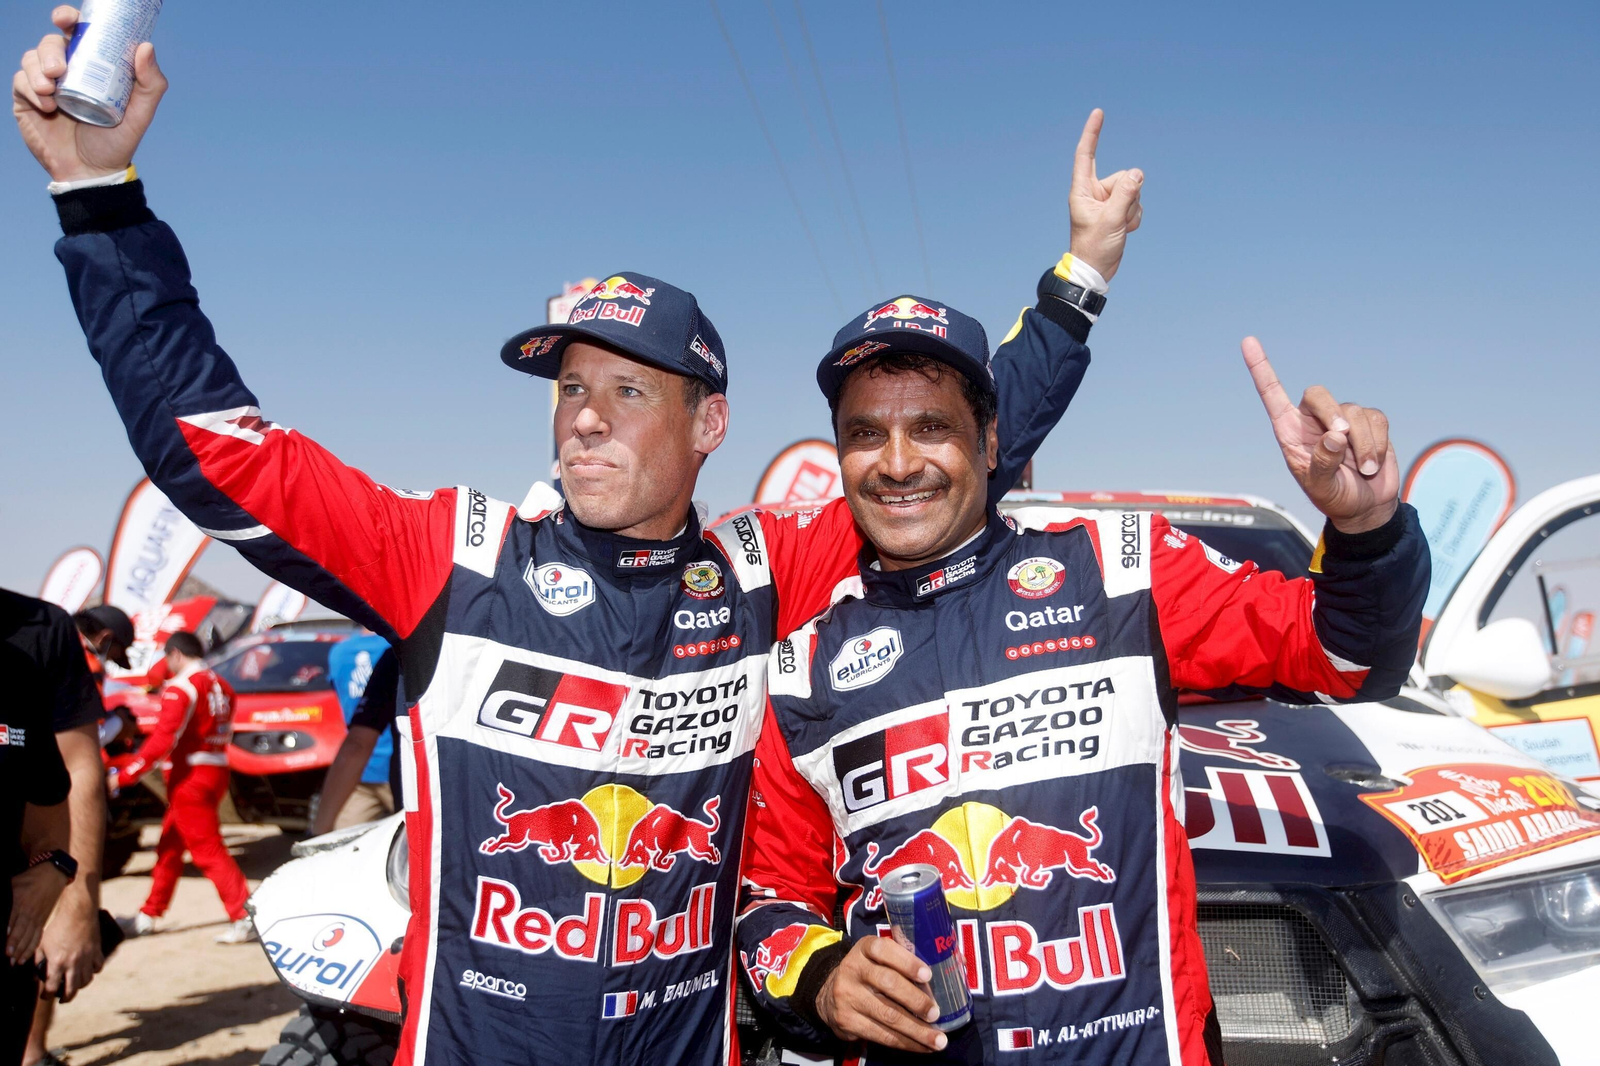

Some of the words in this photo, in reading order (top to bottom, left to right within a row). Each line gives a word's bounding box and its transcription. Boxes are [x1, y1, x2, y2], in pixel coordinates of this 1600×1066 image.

[598, 302, 646, 327] Bull
[1154, 510, 1255, 525] acing
[732, 515, 762, 566] sparco
[1121, 513, 1141, 569] sparco
[619, 555, 648, 567] GR
[944, 555, 977, 573] TOYOTA
[945, 562, 975, 579] GAZOO
[946, 568, 976, 585] Racing
[918, 575, 945, 595] GR
[674, 606, 731, 630] Qata
[1005, 604, 1085, 631] Qatar
[837, 637, 896, 681] eurol
[1005, 635, 1096, 660] ooredoo
[846, 658, 891, 683] LUBRICANTS
[638, 673, 748, 711] TOYOTA
[961, 676, 1115, 721] TOYOTA
[479, 688, 613, 752] GR
[629, 703, 739, 735] GAZOO
[961, 706, 1103, 747] GAZOO
[621, 730, 733, 760] Racing
[960, 734, 1100, 774] Racing
[842, 742, 948, 812] GR
[1407, 798, 1467, 825] 201
[1453, 819, 1528, 862] SAUDI
[471, 876, 606, 962] Red
[612, 882, 717, 966] Bull
[989, 903, 1127, 996] Bull
[460, 969, 527, 1001] sparco
[639, 992, 658, 1010] M.
[663, 969, 720, 1004] BAUMEL
[1037, 1028, 1053, 1046] N.
[1057, 1008, 1146, 1043] AL-ATTIYAH
